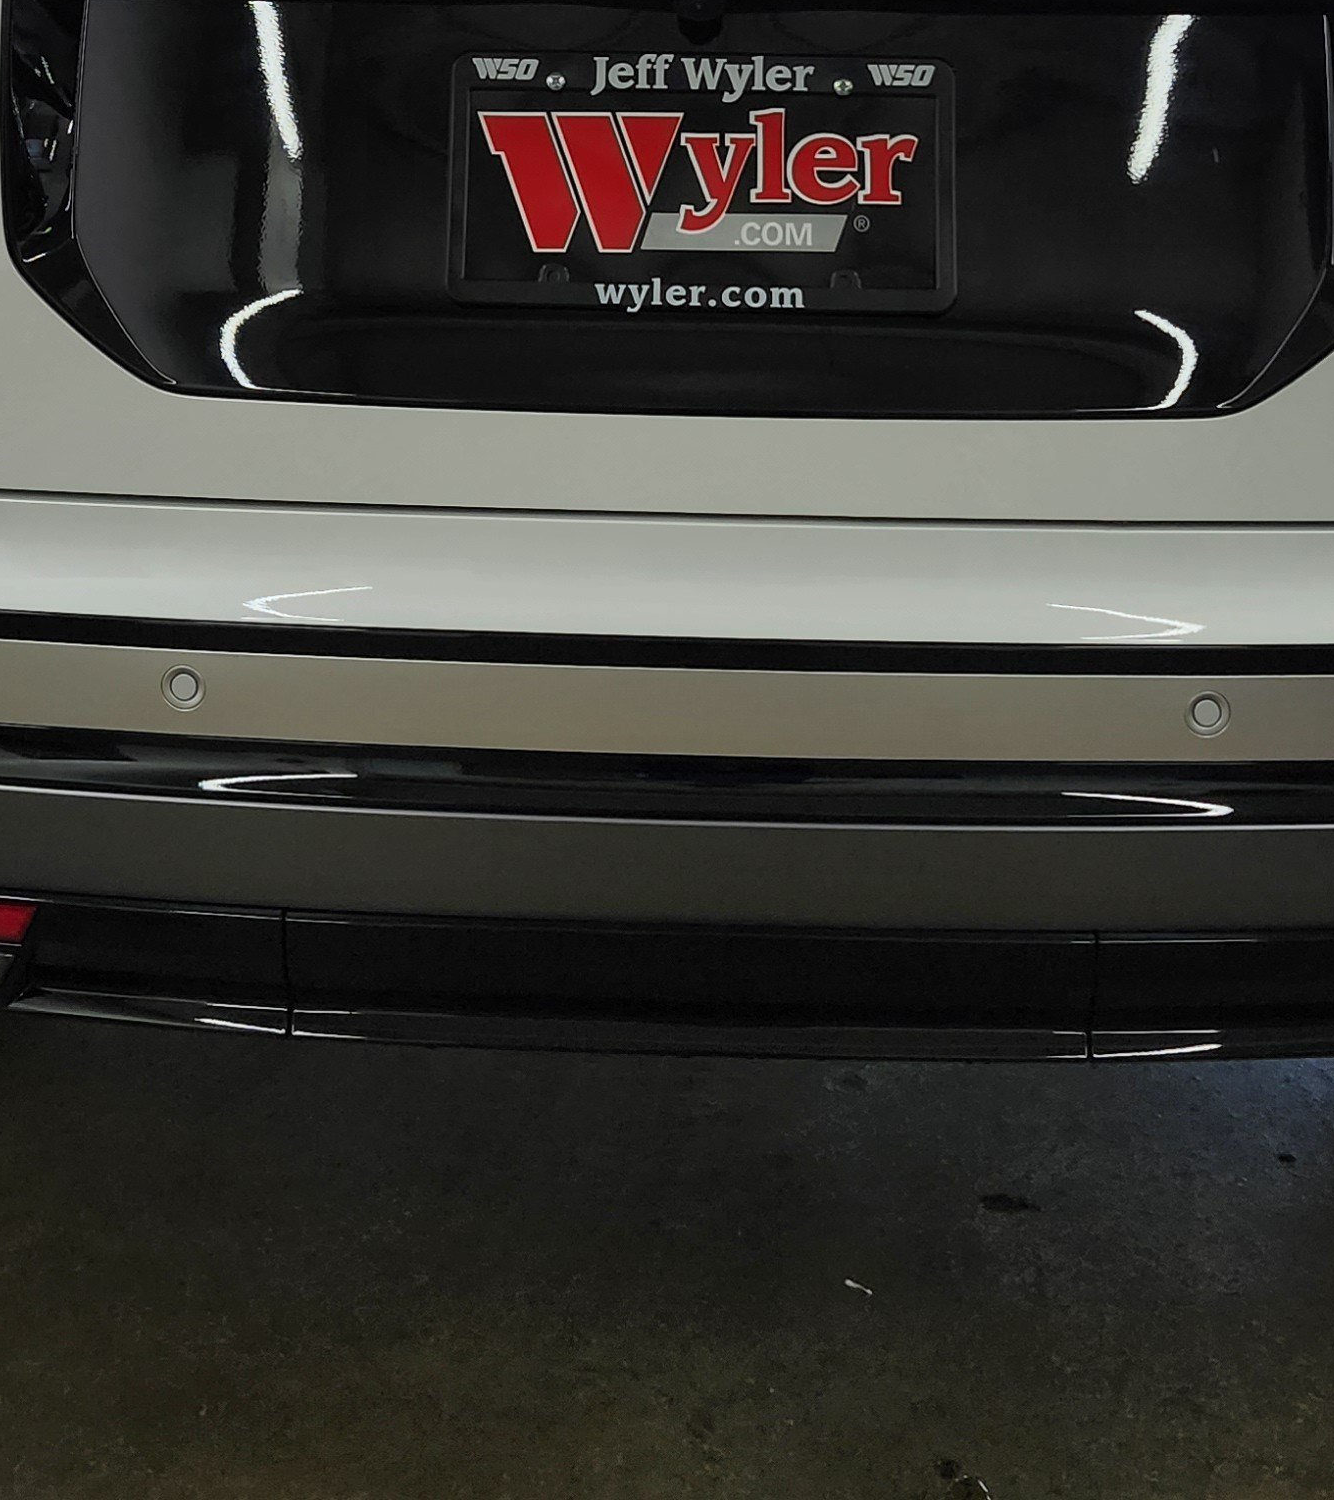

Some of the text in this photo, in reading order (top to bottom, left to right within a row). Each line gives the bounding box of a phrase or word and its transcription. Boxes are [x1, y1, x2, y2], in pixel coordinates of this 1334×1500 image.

[590, 53, 815, 104] Jeff Wyler
[477, 107, 919, 254] Wyler
[733, 220, 813, 248] .COM
[594, 276, 805, 313] wyler.com
